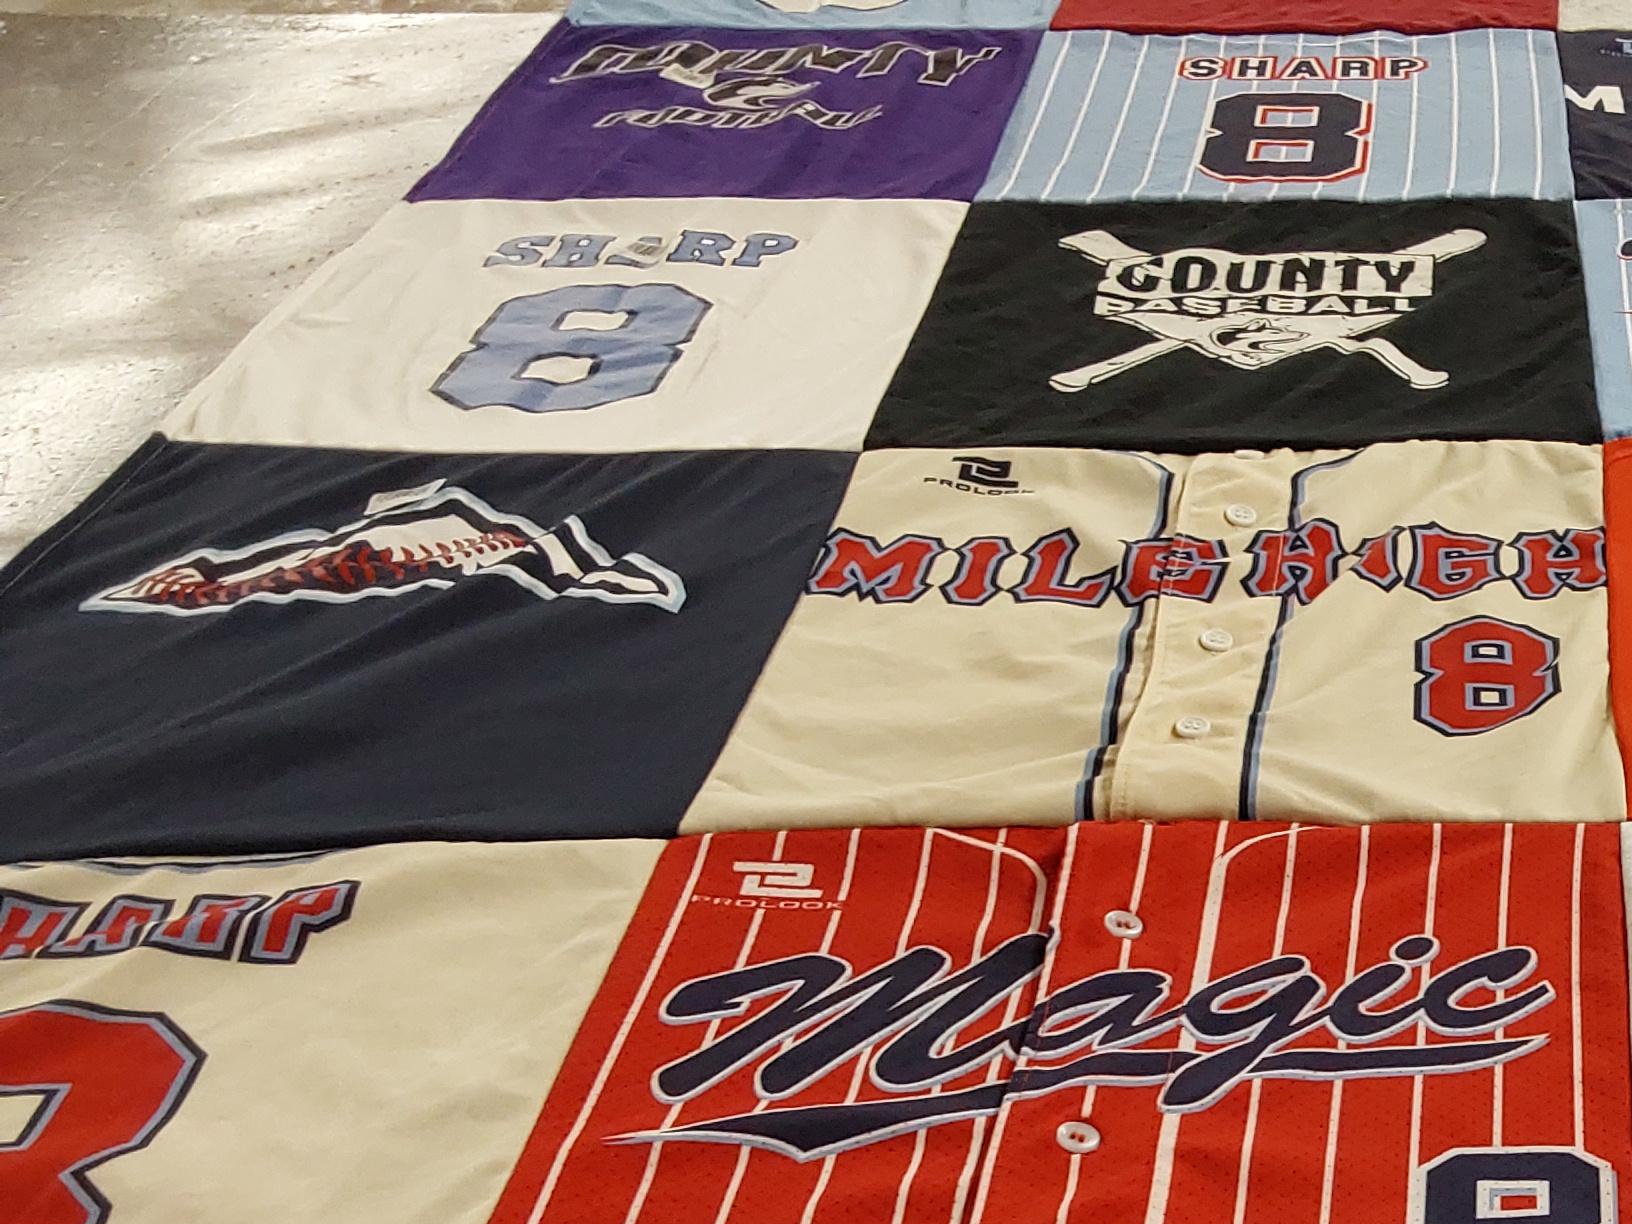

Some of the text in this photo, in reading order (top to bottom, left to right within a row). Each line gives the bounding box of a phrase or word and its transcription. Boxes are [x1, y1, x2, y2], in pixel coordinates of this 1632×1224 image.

[1178, 55, 1428, 82] SHARP
[1197, 91, 1374, 184] 8
[1092, 295, 1420, 317] BASEBALL
[1115, 254, 1416, 294] COUNTY
[428, 282, 714, 414] 8
[804, 526, 1230, 608] MILE
[1414, 614, 1562, 737] 8
[690, 894, 844, 910] PROLOOK
[640, 932, 1556, 1130] Magic
